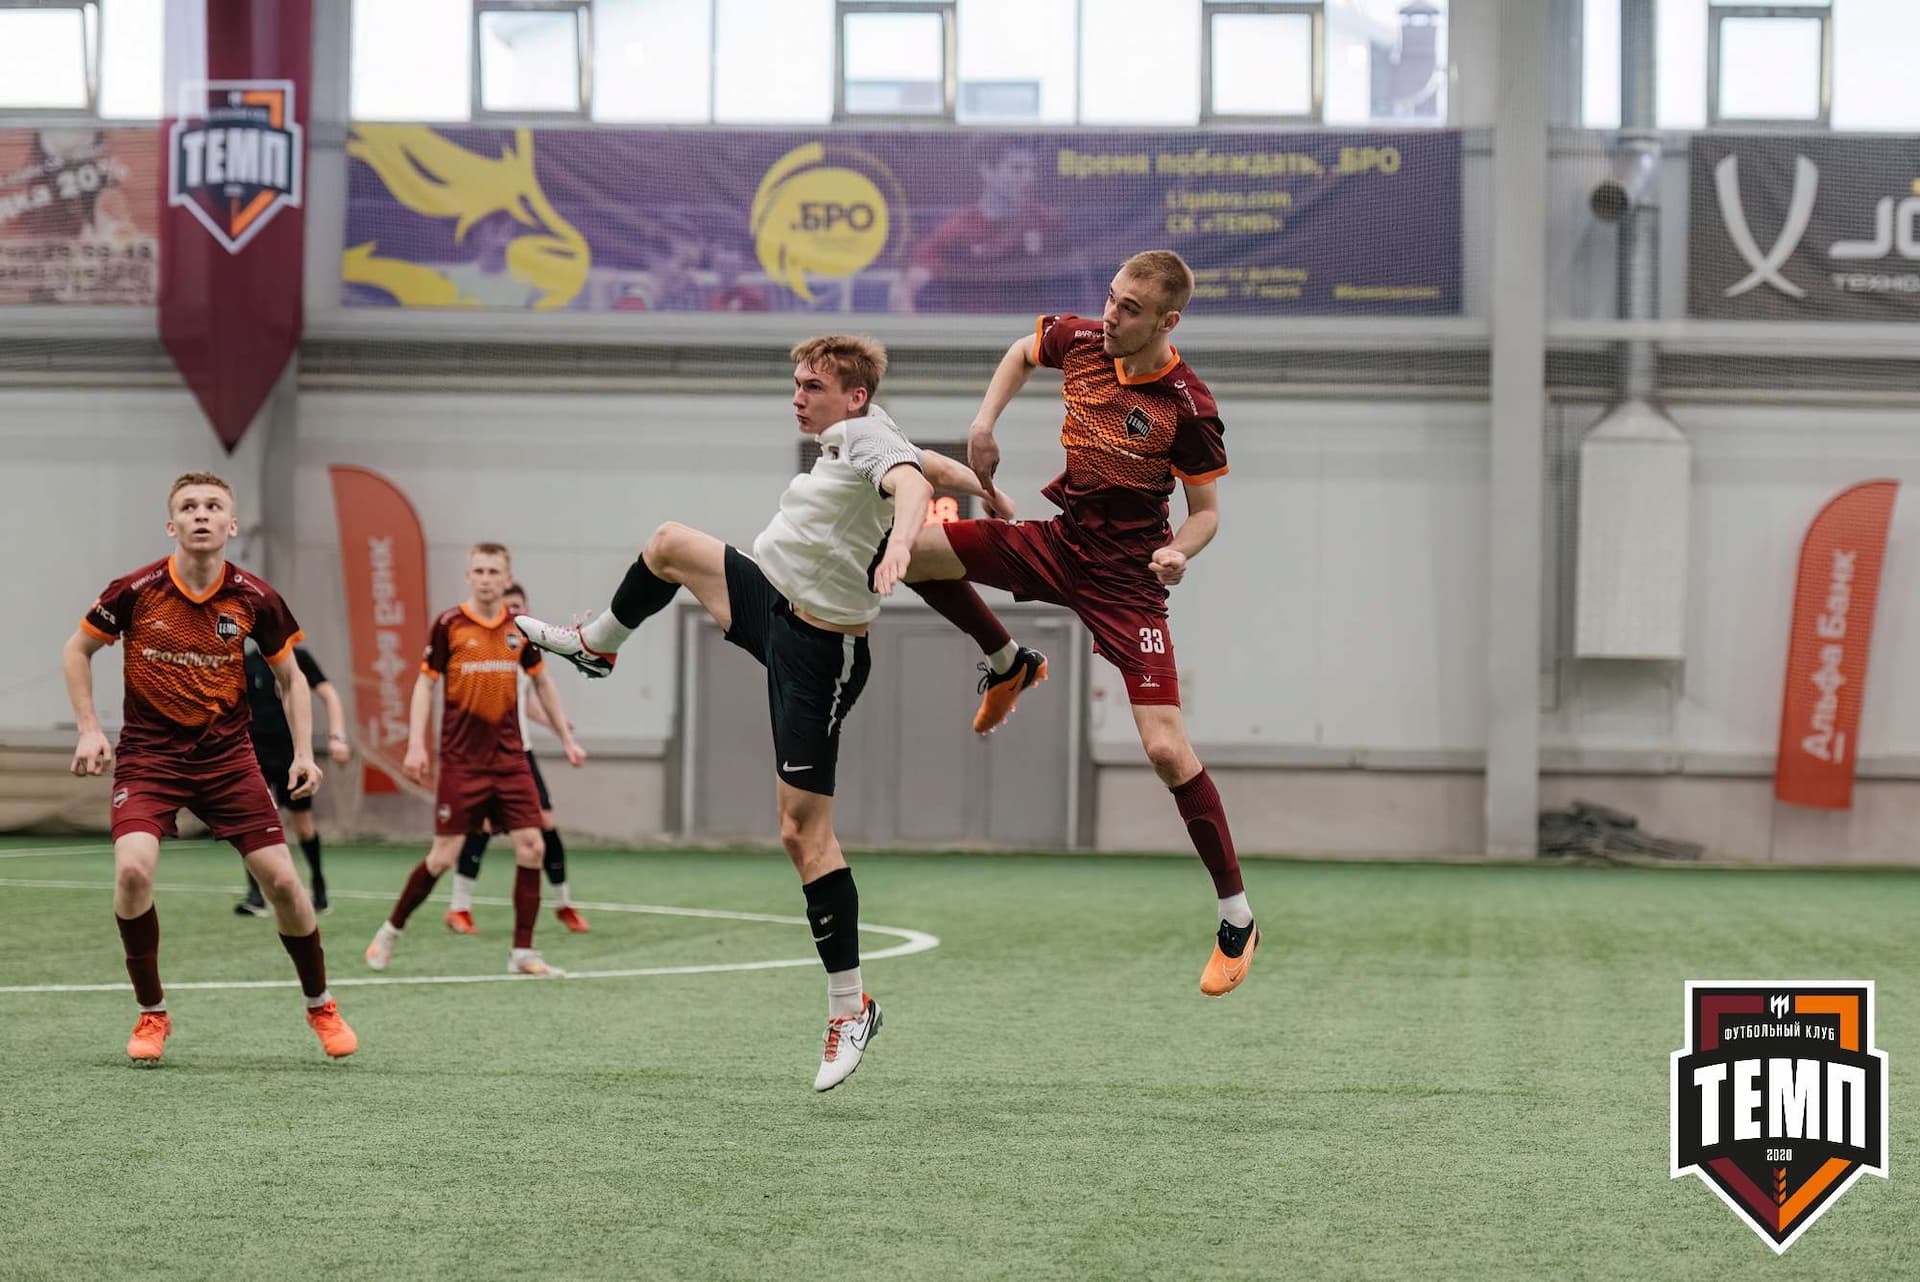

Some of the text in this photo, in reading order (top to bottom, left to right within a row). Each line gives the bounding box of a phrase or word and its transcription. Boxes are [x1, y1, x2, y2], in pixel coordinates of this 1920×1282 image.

[182, 127, 288, 188] ТЕМП
[1057, 149, 1149, 178] Время
[1139, 627, 1165, 654] 33
[1801, 549, 1856, 762] Альфа Банк
